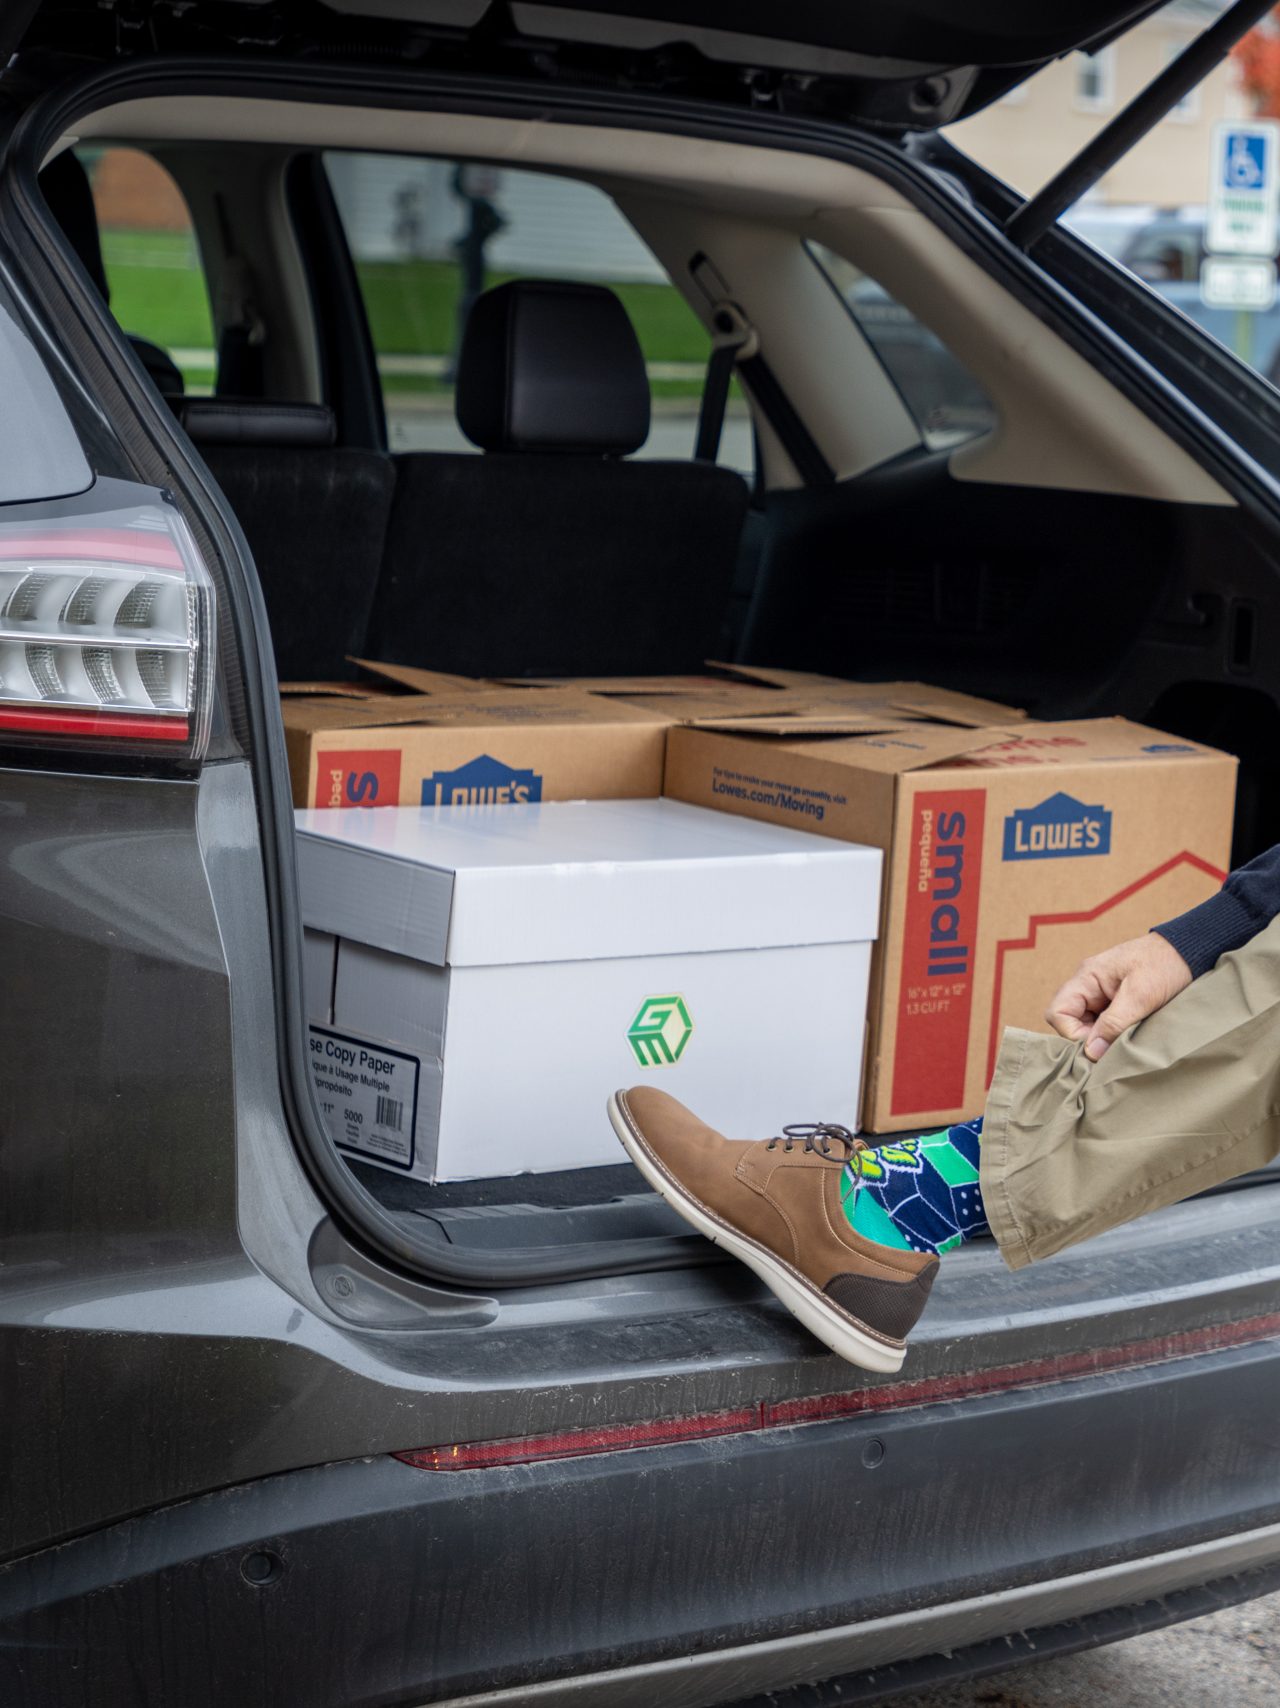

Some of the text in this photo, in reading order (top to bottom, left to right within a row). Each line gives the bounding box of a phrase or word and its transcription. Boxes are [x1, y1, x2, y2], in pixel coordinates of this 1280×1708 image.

[712, 778, 825, 821] Lowes.com/Moving
[918, 809, 933, 893] pequeña
[1014, 816, 1101, 853] LOWE'S
[927, 811, 968, 976] small
[309, 1038, 396, 1076] se Copy Paper
[335, 1066, 359, 1084] Usage
[360, 1073, 391, 1093] Multiple
[344, 1108, 364, 1125] 5000
